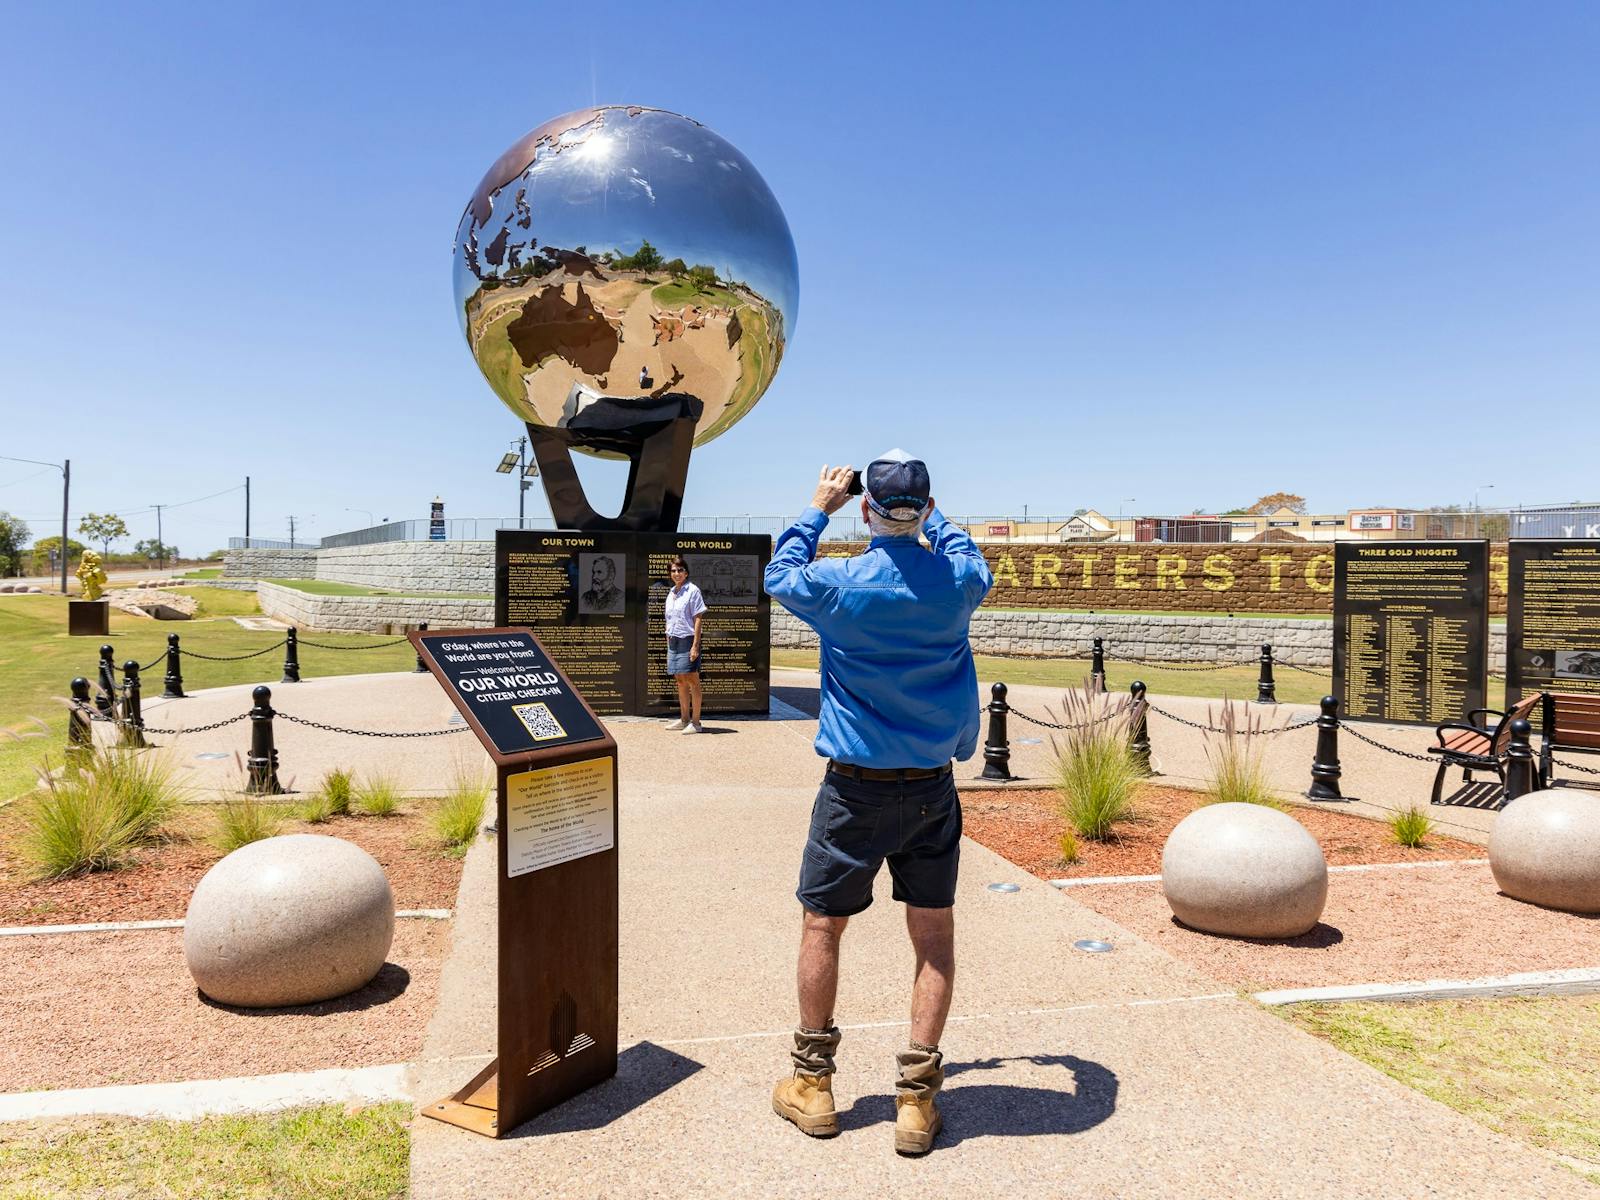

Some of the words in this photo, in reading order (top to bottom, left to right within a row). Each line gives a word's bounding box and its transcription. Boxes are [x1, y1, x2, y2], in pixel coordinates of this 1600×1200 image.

[542, 538, 564, 546] OUR
[565, 538, 594, 546] TOWN
[676, 541, 696, 549] OUR
[699, 541, 732, 550] WORLD
[993, 553, 1235, 592] ARTERS
[442, 642, 472, 651] G'day,
[474, 641, 499, 650] where
[445, 653, 476, 663] World
[477, 653, 492, 661] are
[494, 652, 510, 662] you
[509, 650, 535, 659] from?
[477, 667, 514, 675] Welcome
[459, 677, 498, 692] OUR
[498, 672, 558, 689] WORLD
[476, 692, 517, 703] CITIZEN
[518, 687, 562, 699] CHECK-IN
